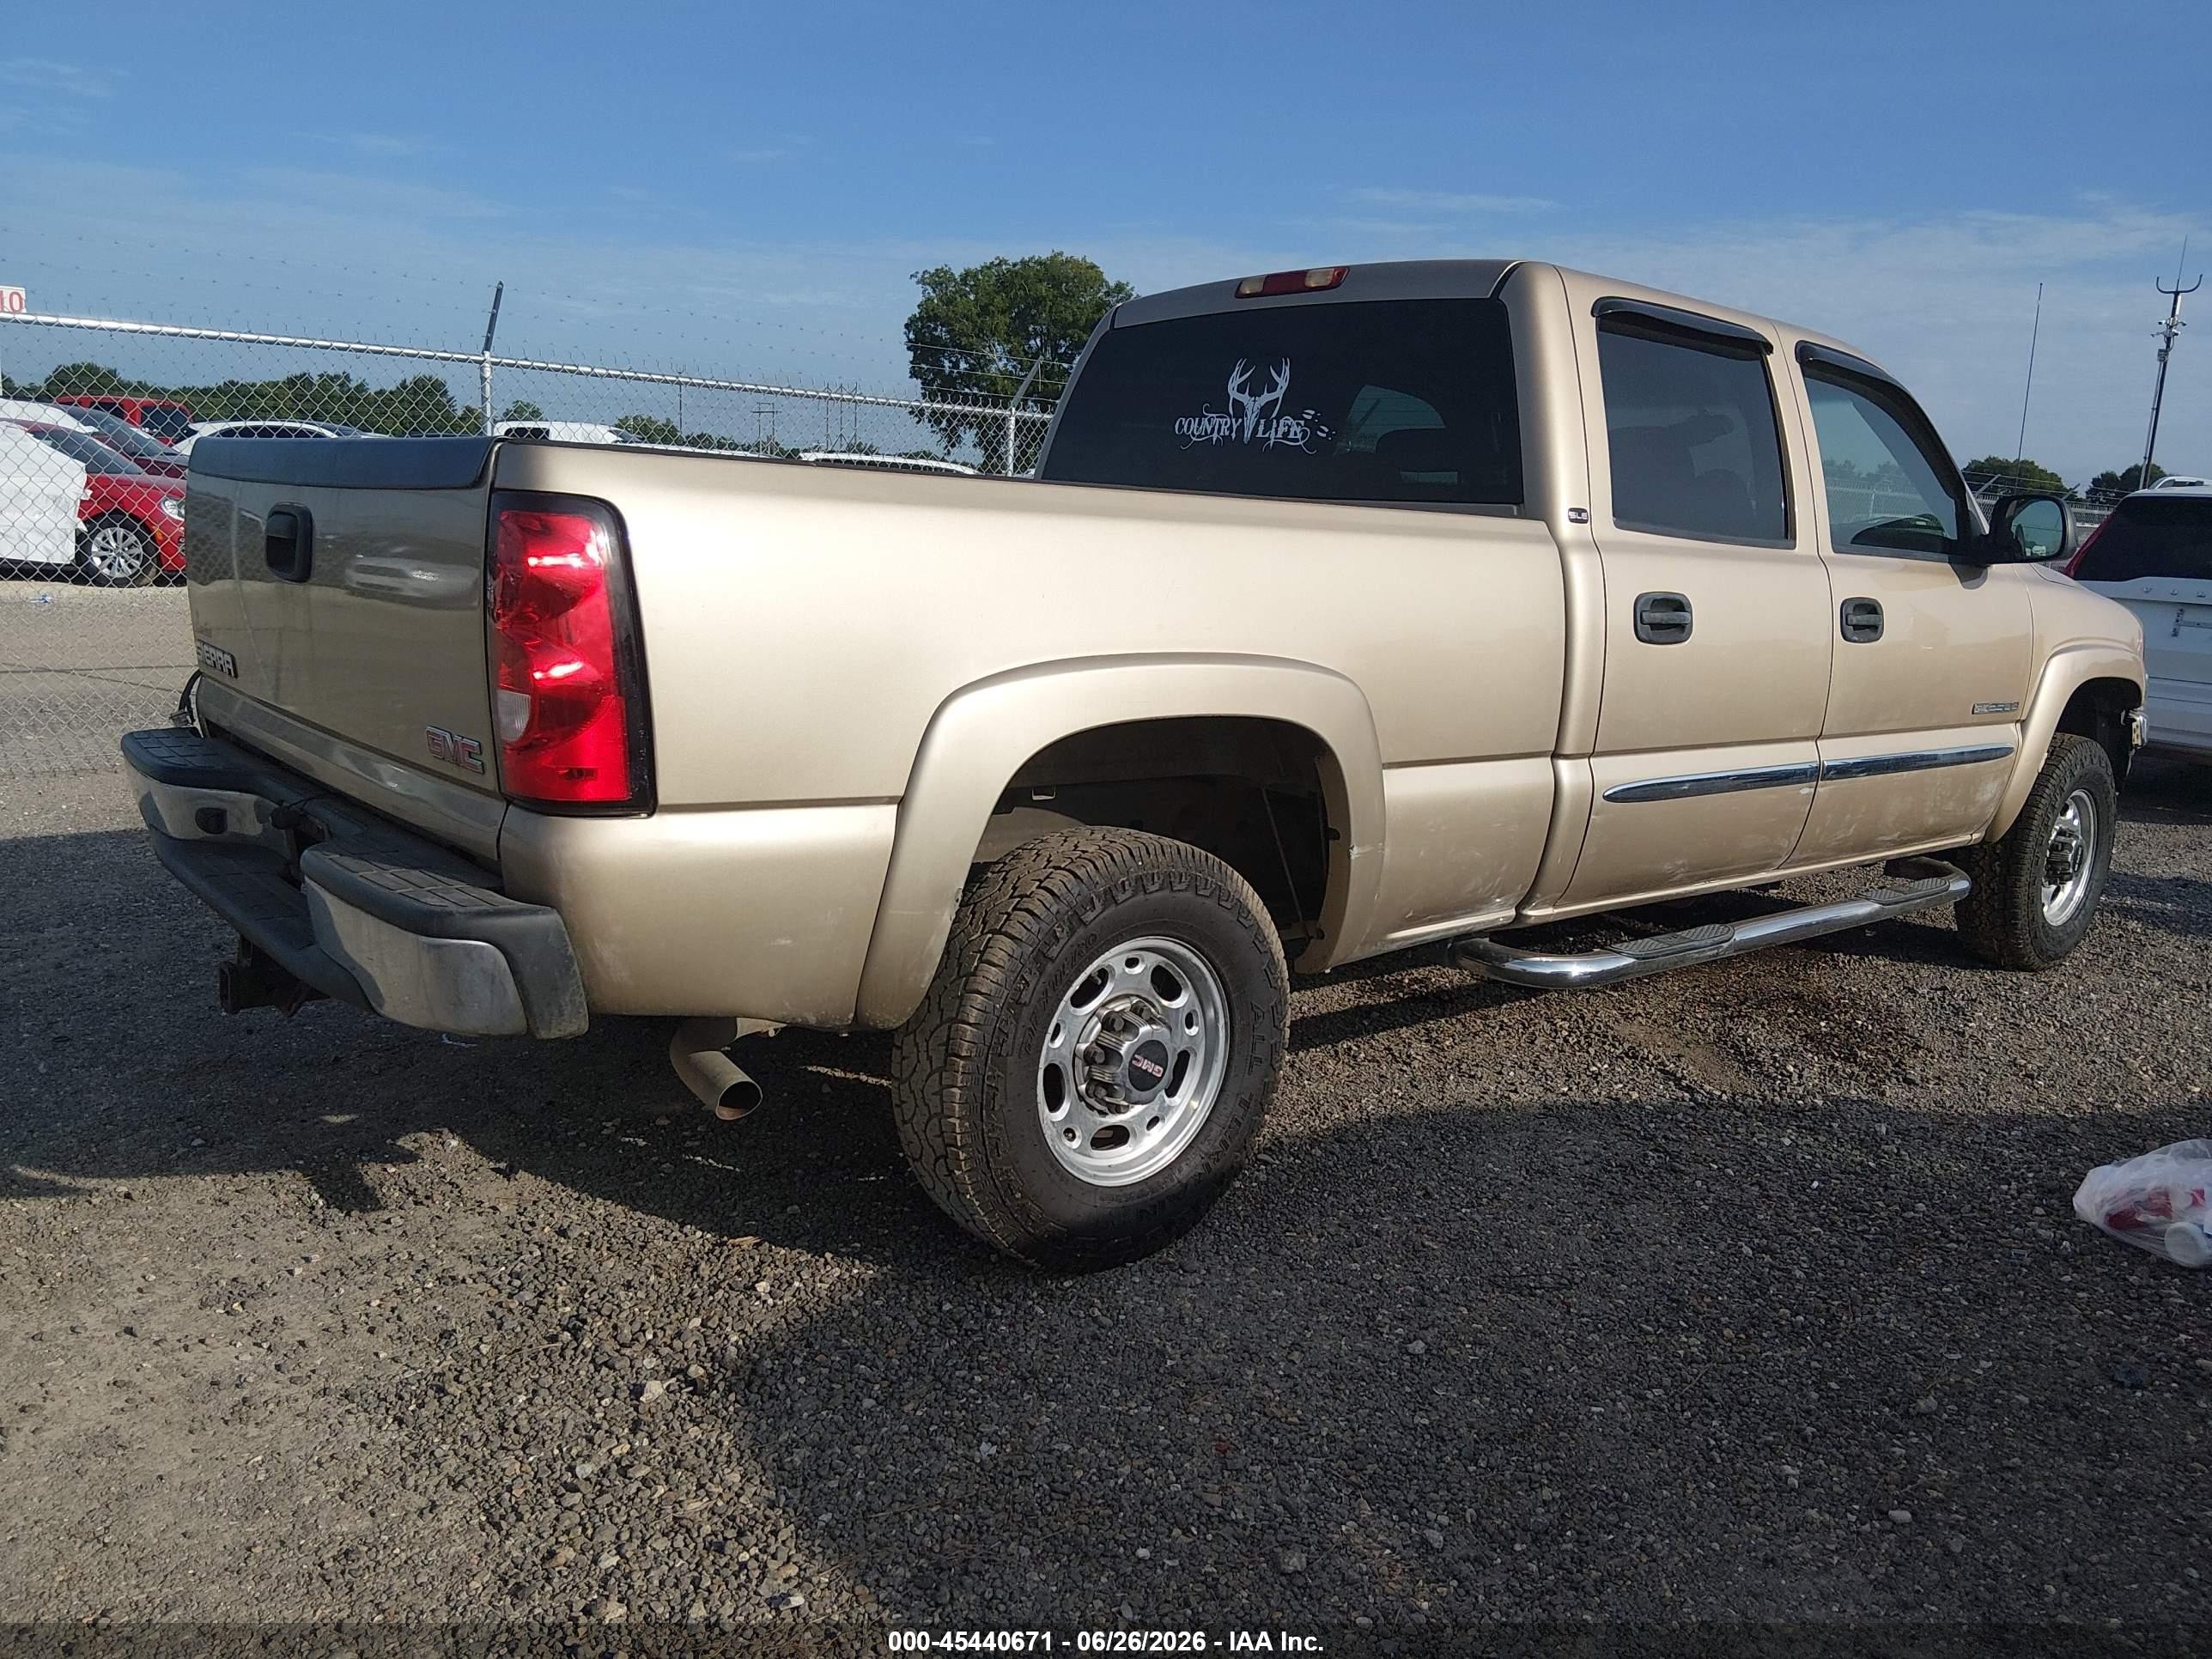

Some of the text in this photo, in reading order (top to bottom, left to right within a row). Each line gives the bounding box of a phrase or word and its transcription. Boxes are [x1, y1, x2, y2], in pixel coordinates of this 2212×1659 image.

[1174, 406, 1311, 449] COUNTRY LIFE
[1568, 511, 1589, 520] SLE
[197, 640, 234, 678] SIERRA
[425, 726, 485, 775] GMC
[1131, 1054, 1164, 1079] GMC
